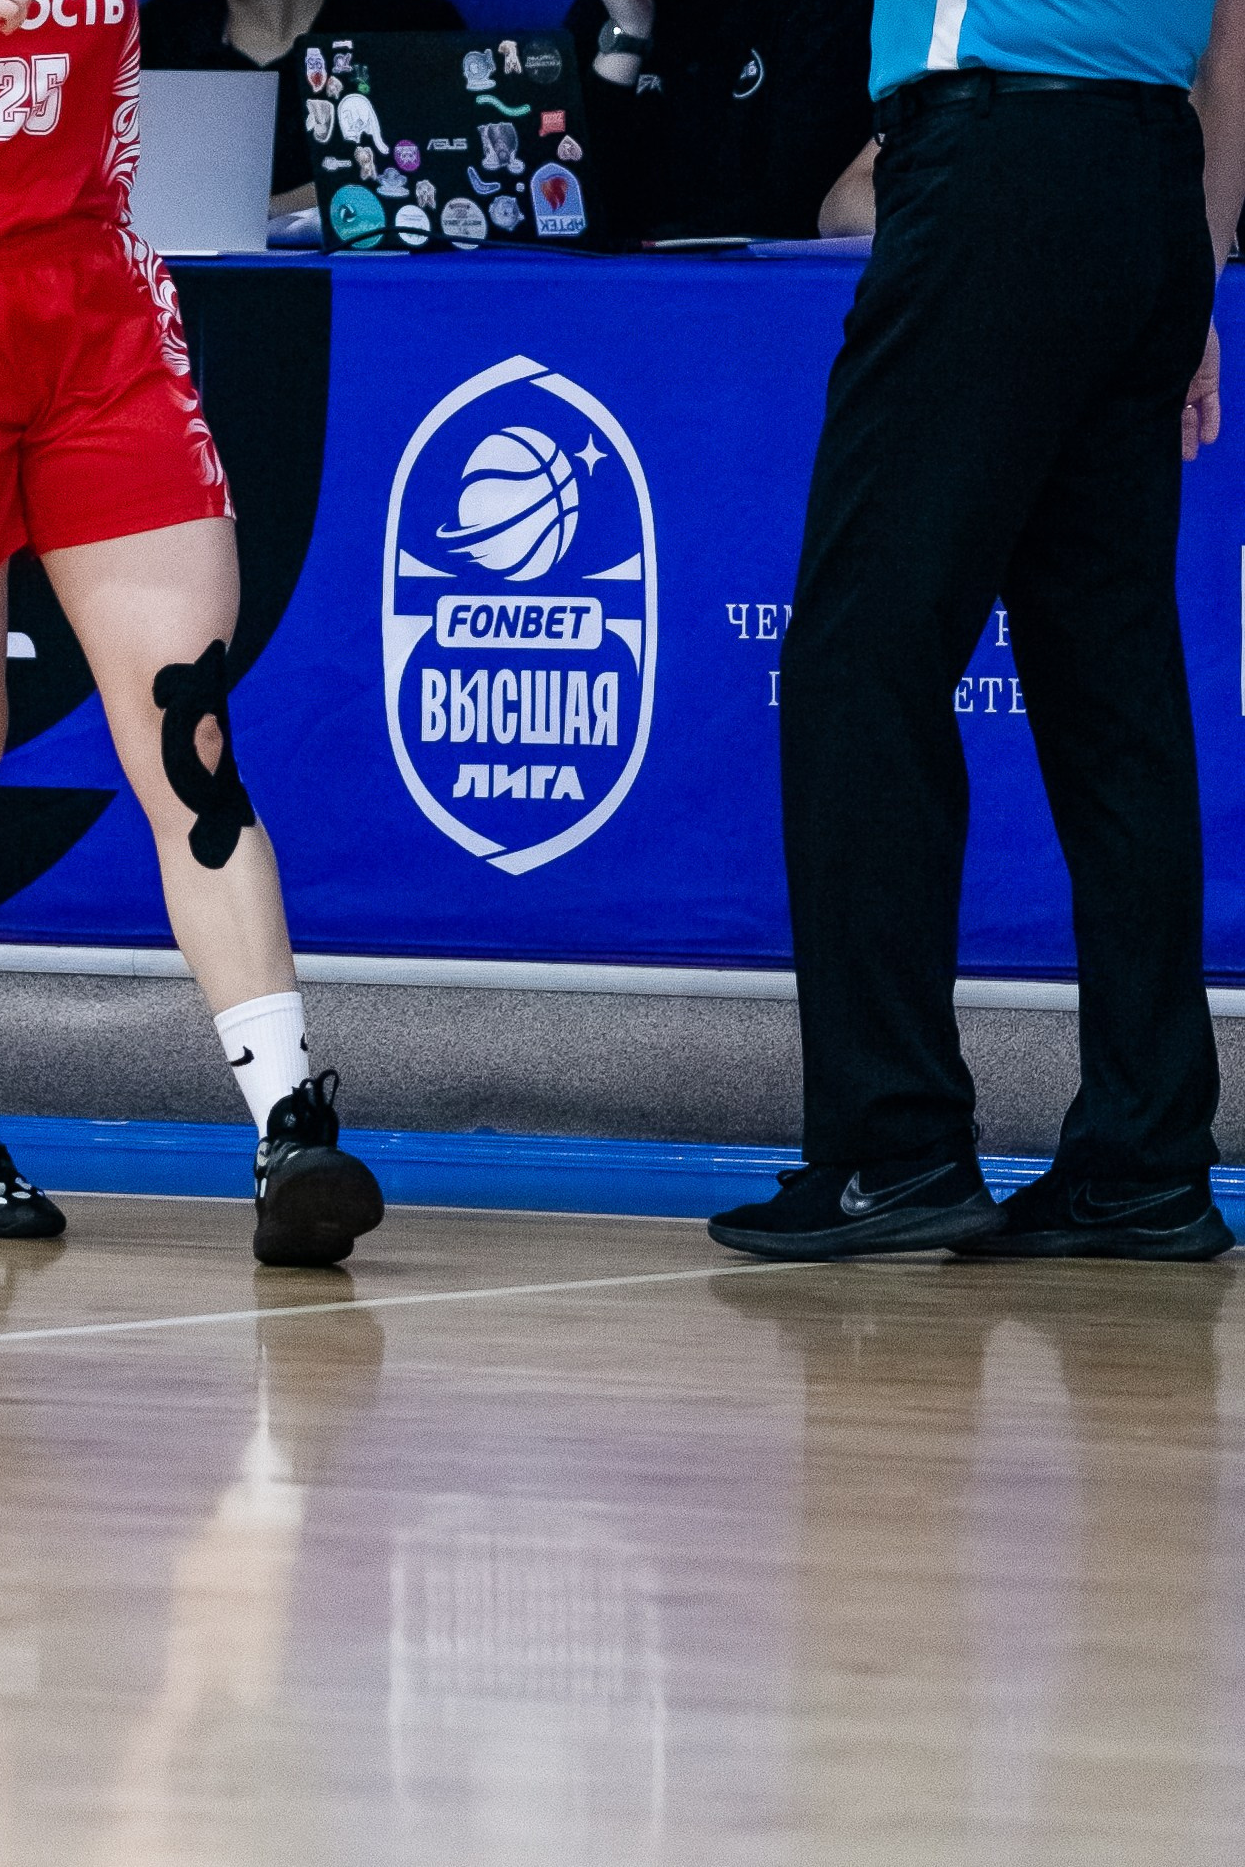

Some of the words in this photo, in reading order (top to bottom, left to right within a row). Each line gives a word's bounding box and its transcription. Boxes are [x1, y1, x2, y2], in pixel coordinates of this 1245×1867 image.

[427, 138, 468, 151] ASUS
[447, 604, 591, 640] FONBET
[421, 668, 619, 746] ВЫСШАЯ
[452, 764, 585, 800] ЛИГА
